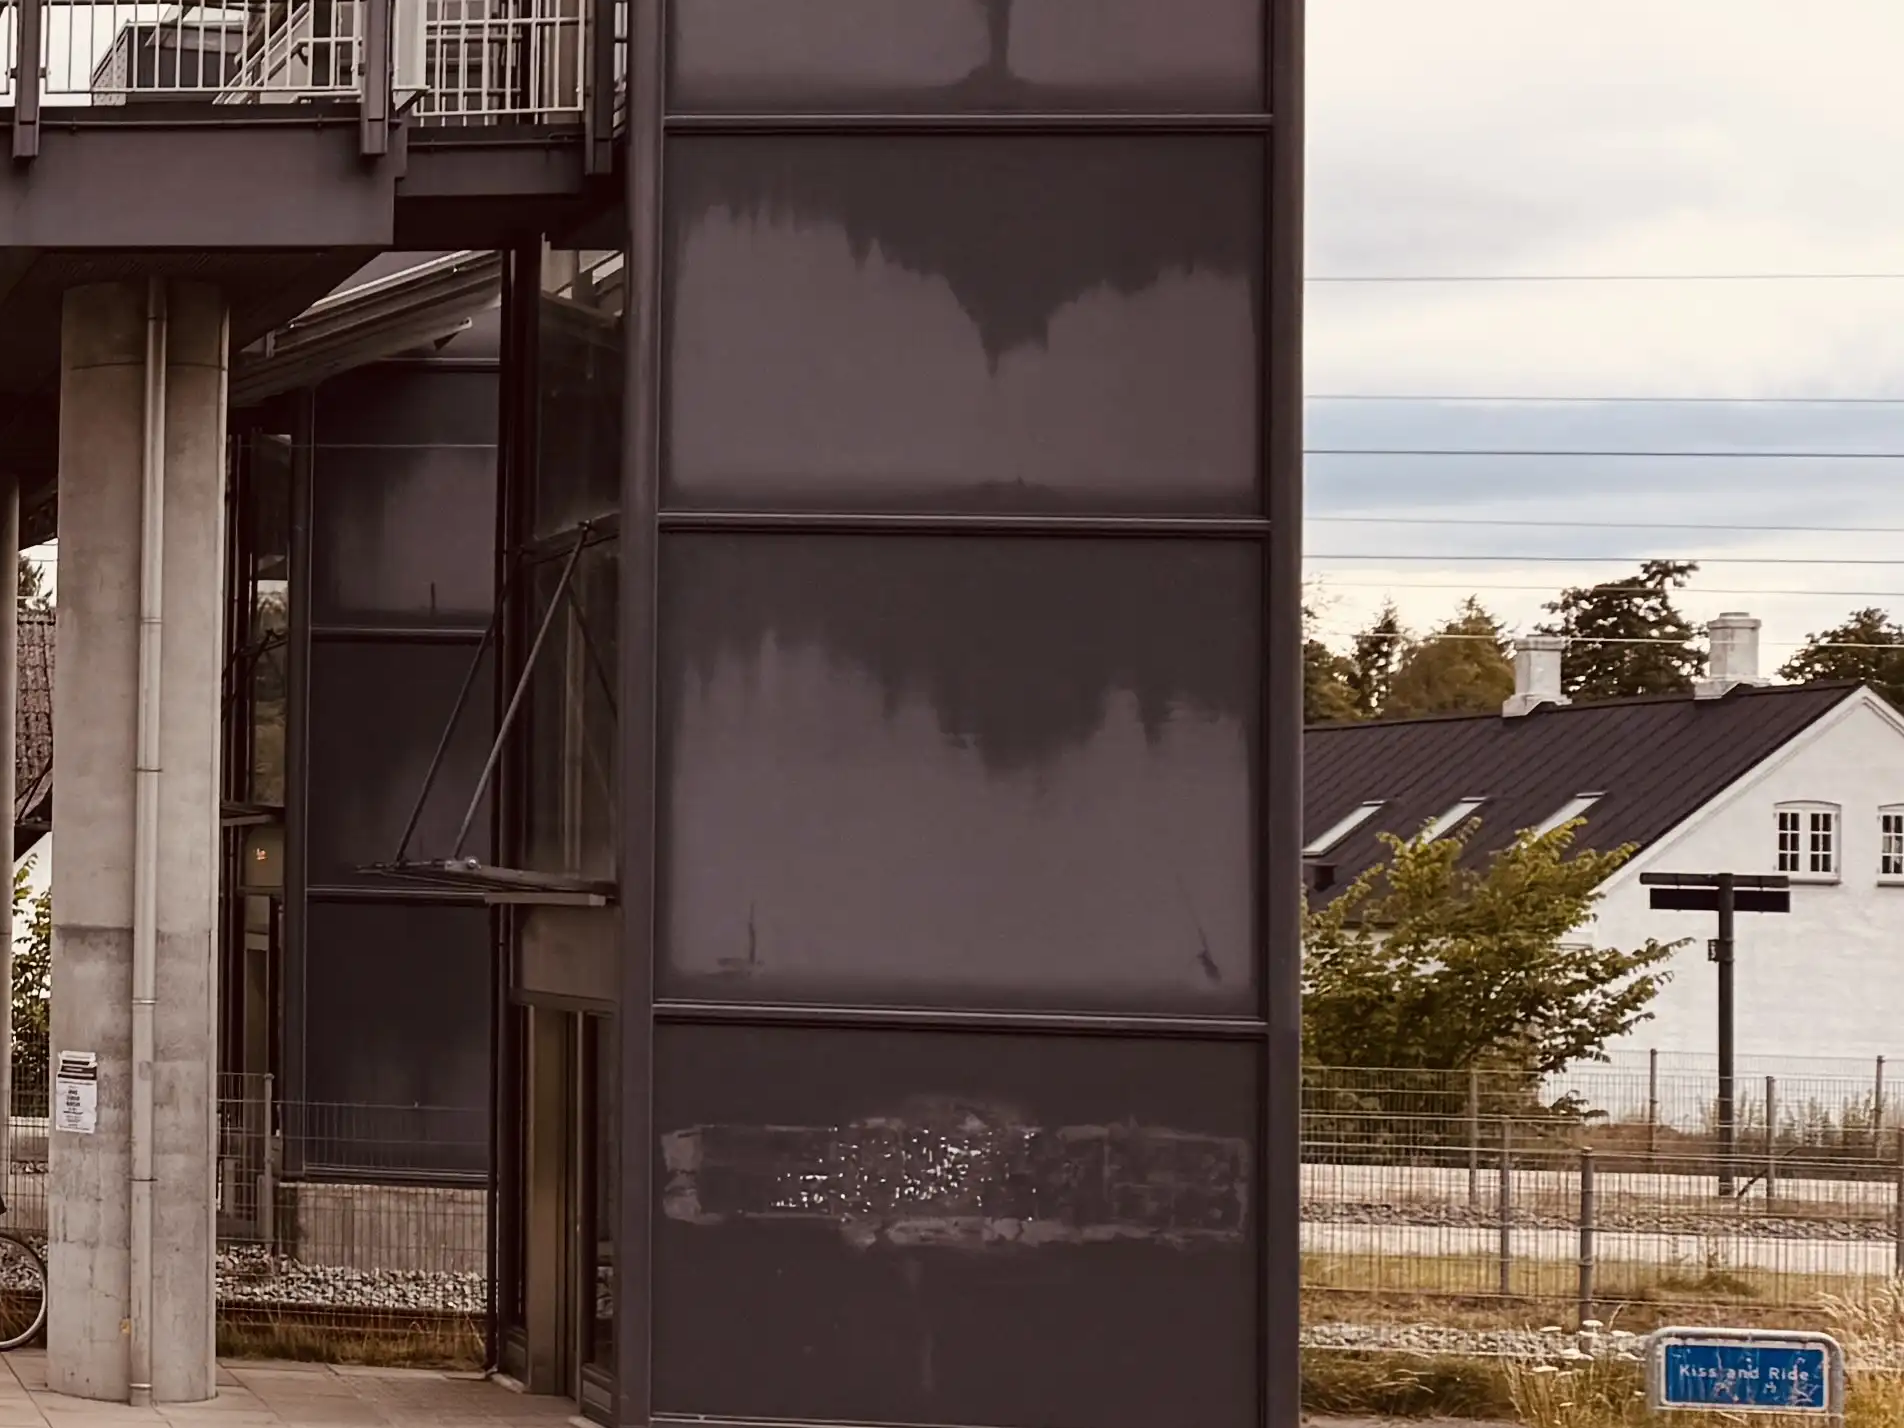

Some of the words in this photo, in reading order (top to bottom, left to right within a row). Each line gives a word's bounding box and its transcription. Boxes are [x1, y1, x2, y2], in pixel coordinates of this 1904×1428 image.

[1679, 1363, 1718, 1378] Kiss
[1726, 1366, 1760, 1380] and
[1768, 1366, 1810, 1381] Ride
